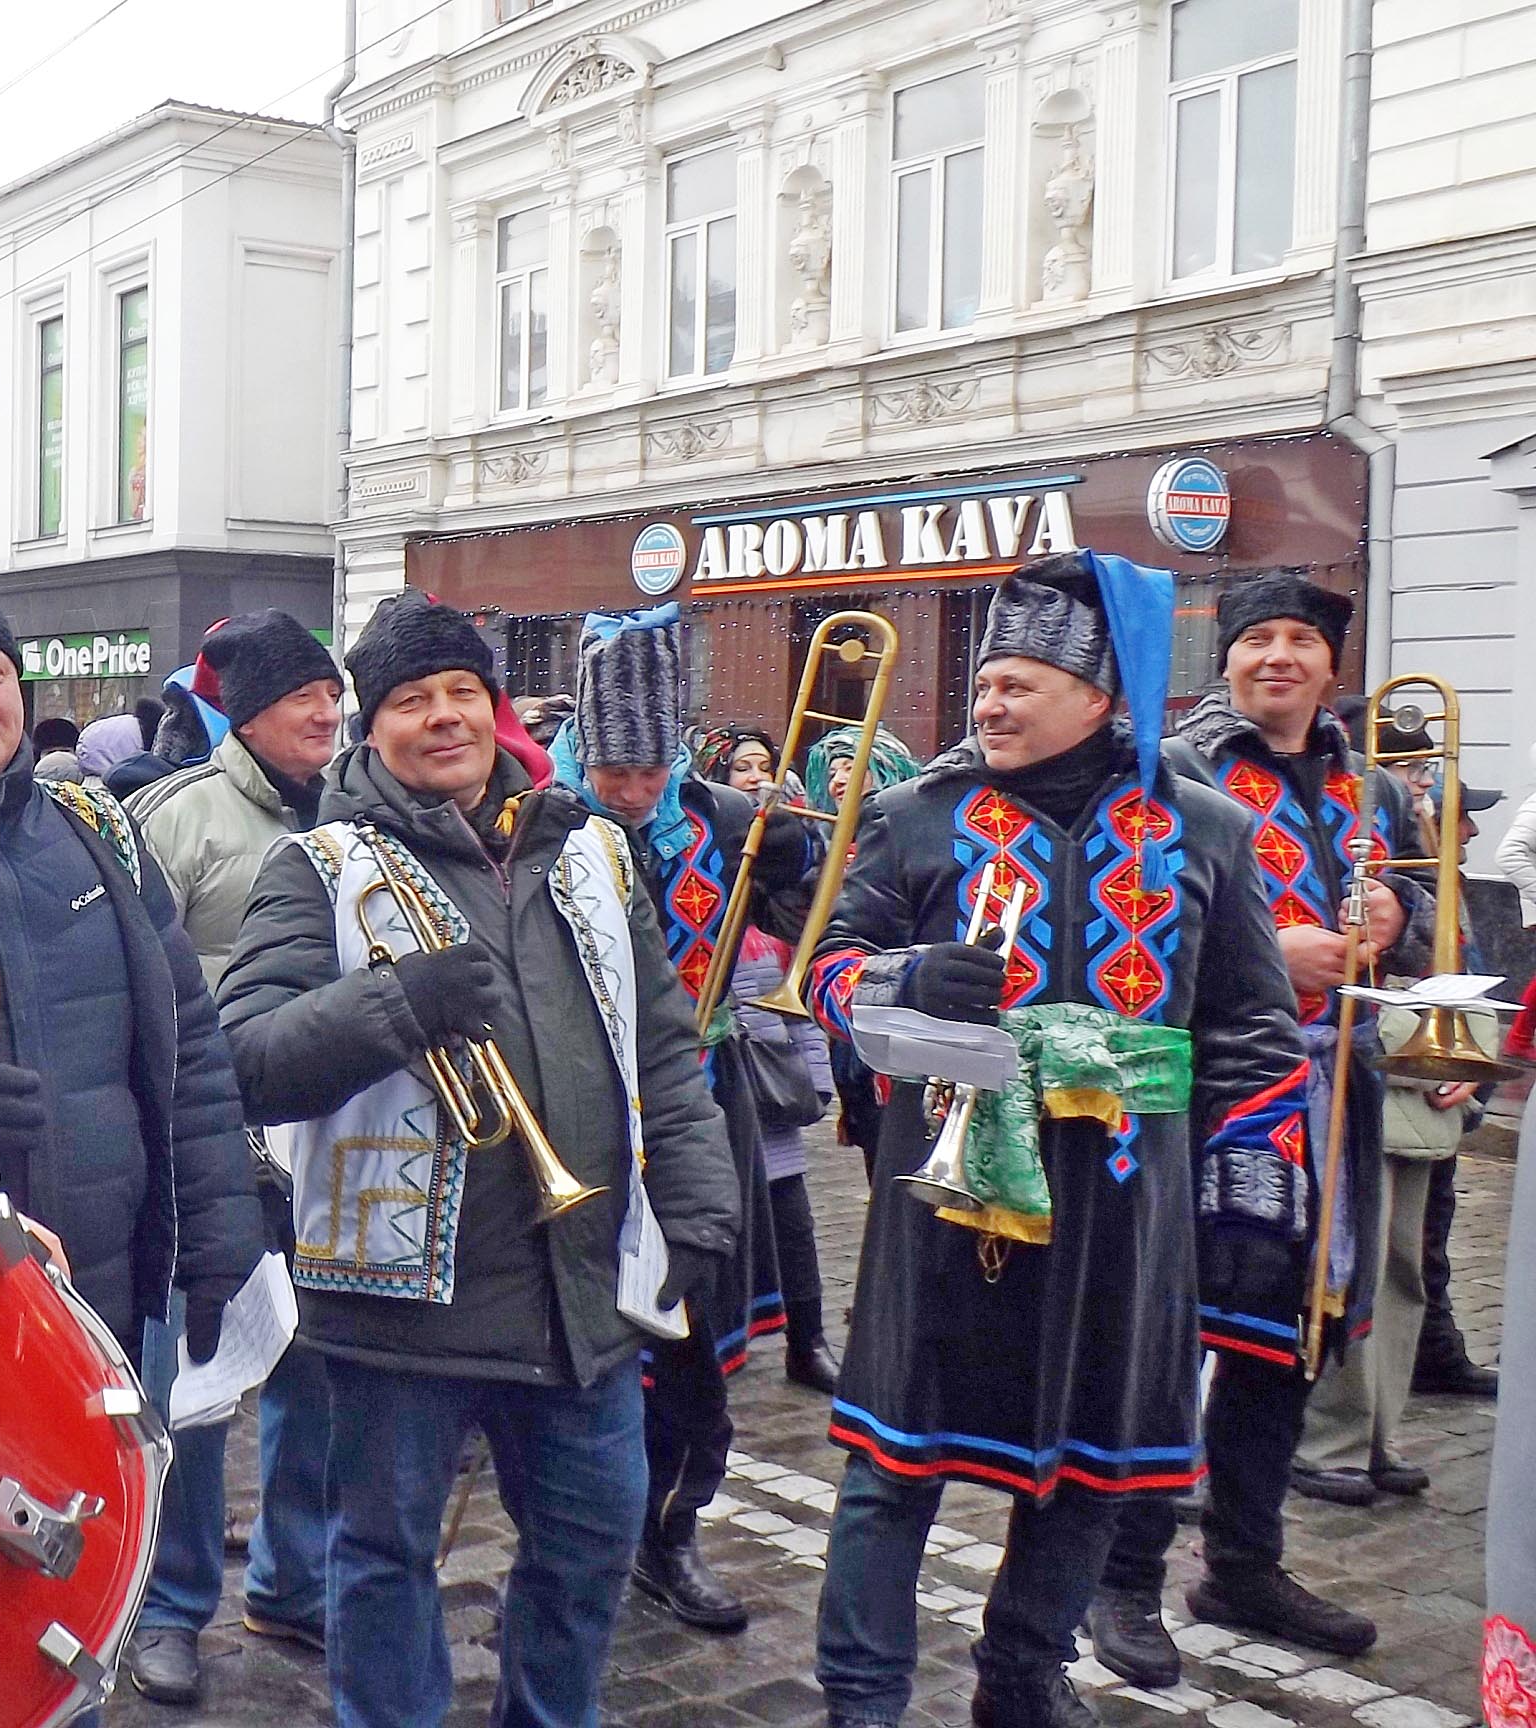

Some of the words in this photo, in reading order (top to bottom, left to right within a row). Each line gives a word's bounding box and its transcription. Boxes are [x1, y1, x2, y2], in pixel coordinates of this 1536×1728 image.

[1166, 495, 1200, 513] AROMA
[1202, 497, 1227, 514] KAVA
[692, 510, 888, 581] AROMA
[900, 490, 1079, 566] KAVA
[45, 633, 151, 676] OnePrice
